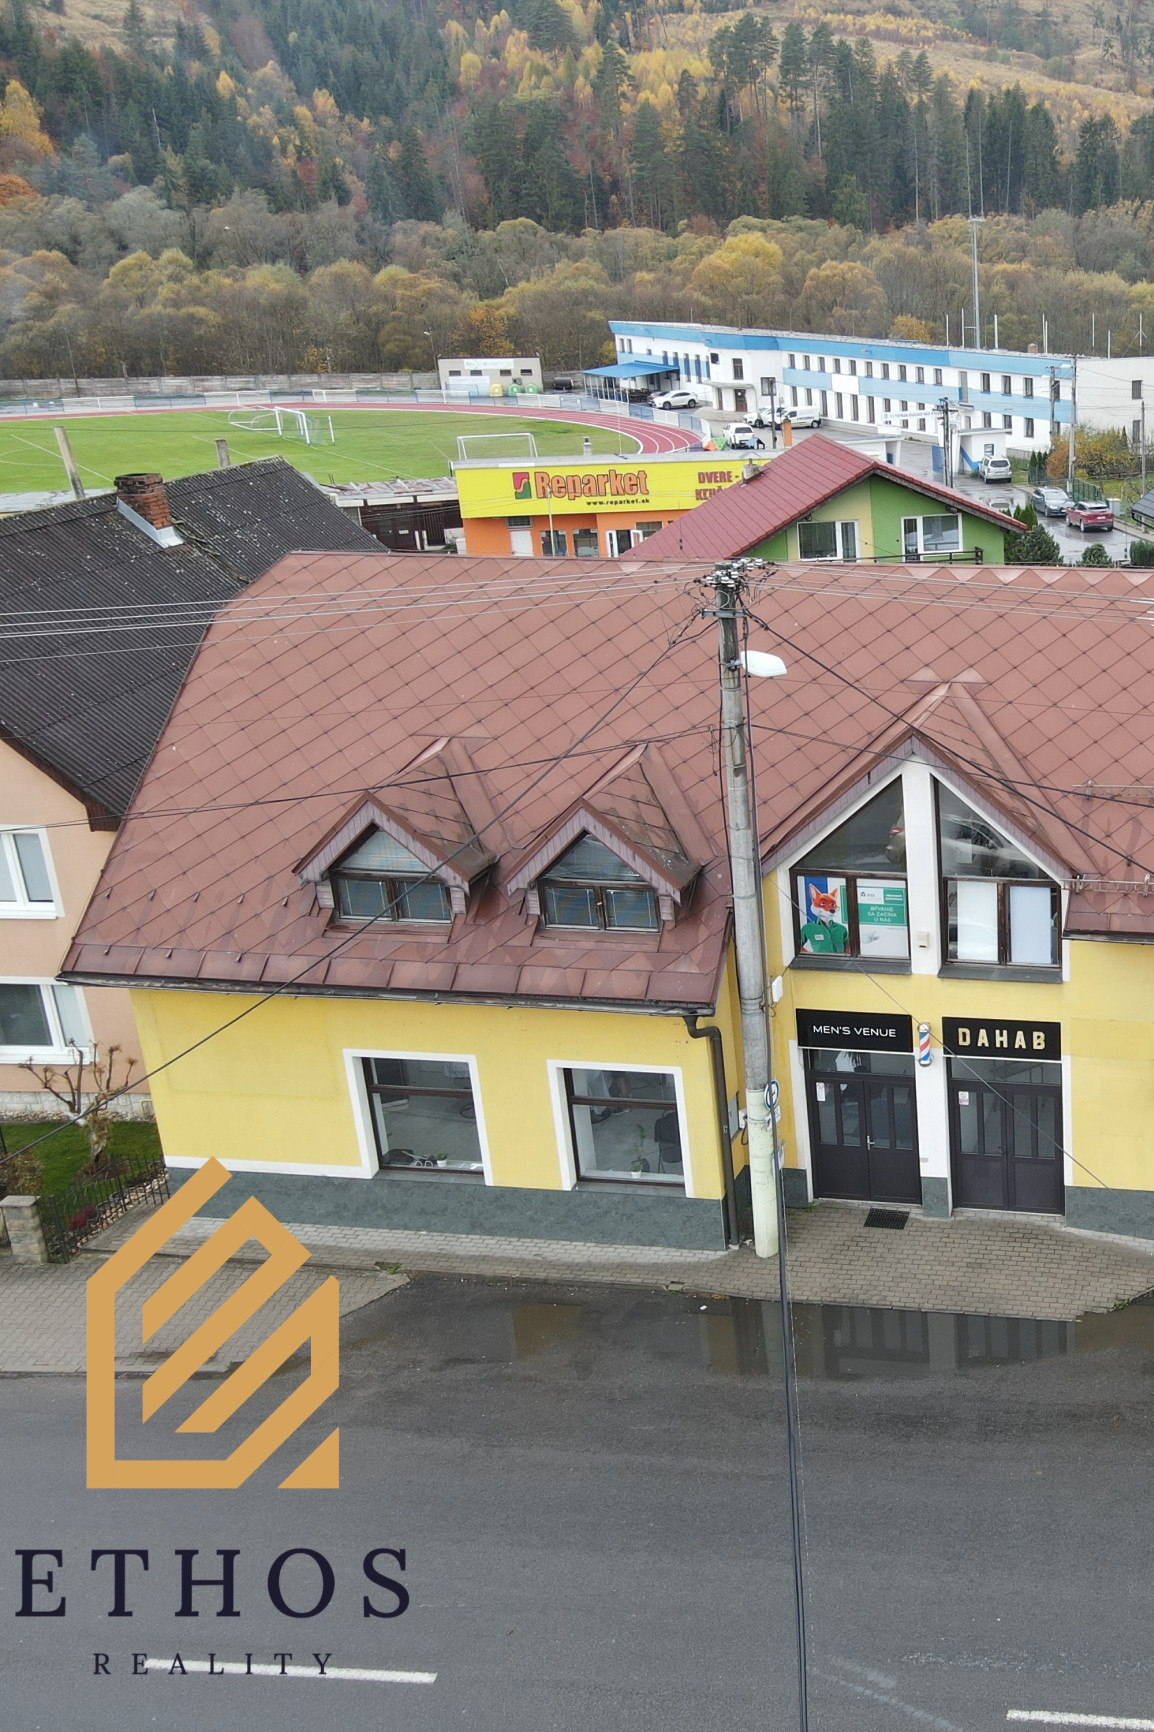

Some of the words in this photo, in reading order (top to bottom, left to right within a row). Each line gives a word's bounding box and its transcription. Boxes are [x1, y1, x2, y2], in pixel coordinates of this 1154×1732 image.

[534, 469, 650, 500] Reparket
[697, 471, 733, 483] DVERE
[812, 1025, 851, 1036] MEN'S
[853, 1027, 897, 1038] VENUE
[957, 1027, 1046, 1050] DAHAB
